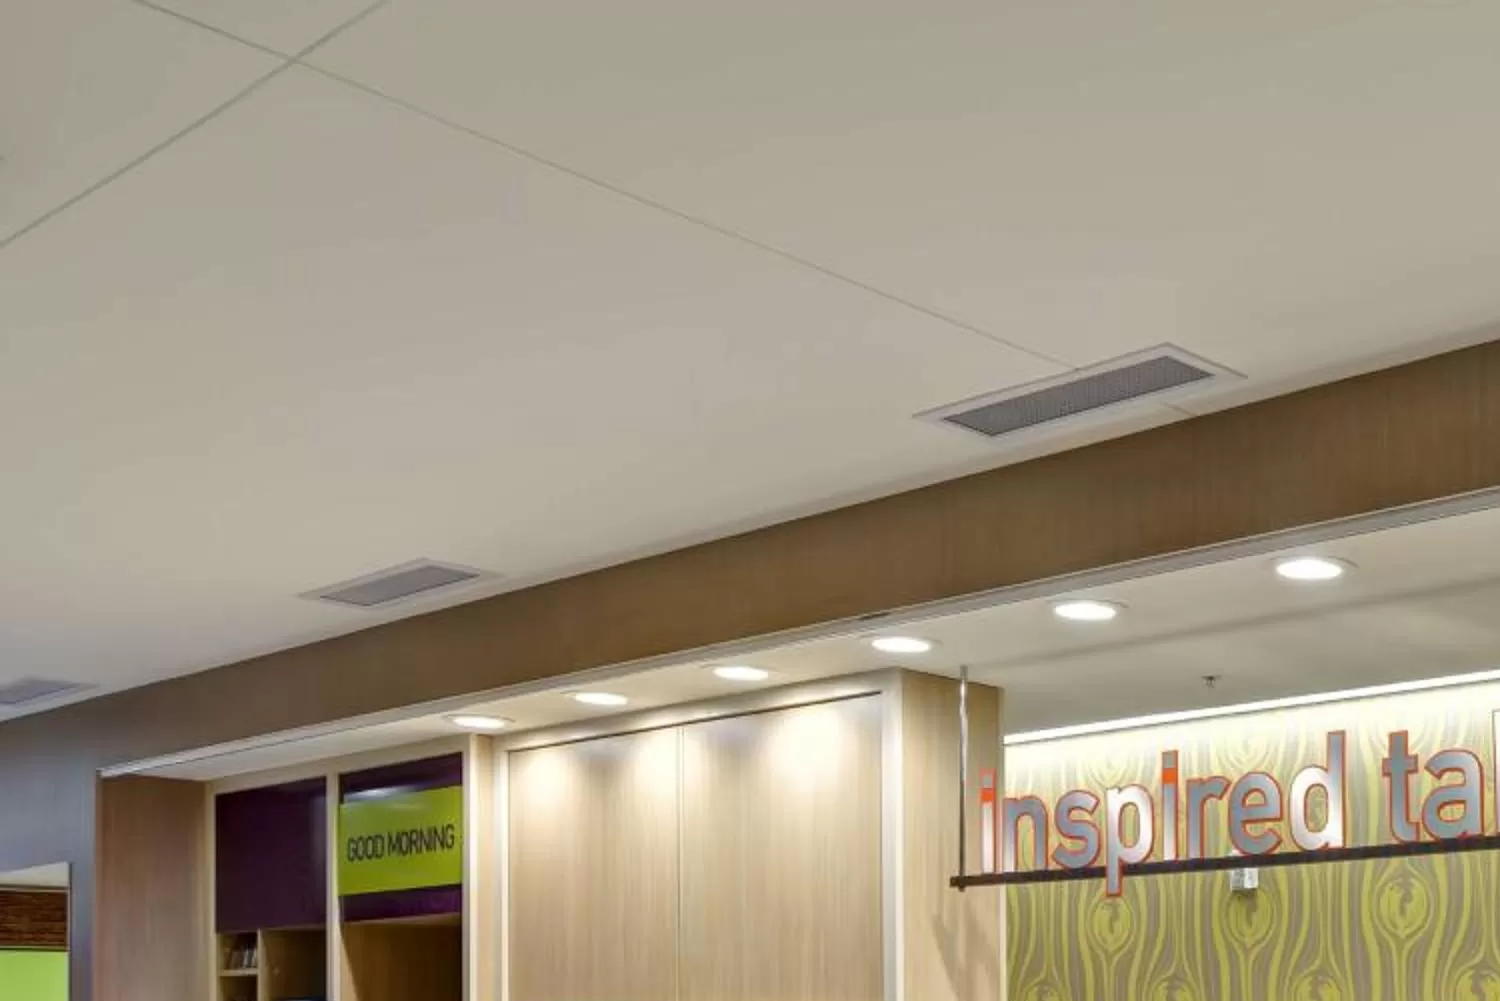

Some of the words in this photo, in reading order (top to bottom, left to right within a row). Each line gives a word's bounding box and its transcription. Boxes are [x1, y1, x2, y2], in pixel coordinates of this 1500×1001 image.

[347, 834, 385, 862] GOOD
[387, 823, 455, 856] MORNING
[979, 730, 1346, 897] inspired
